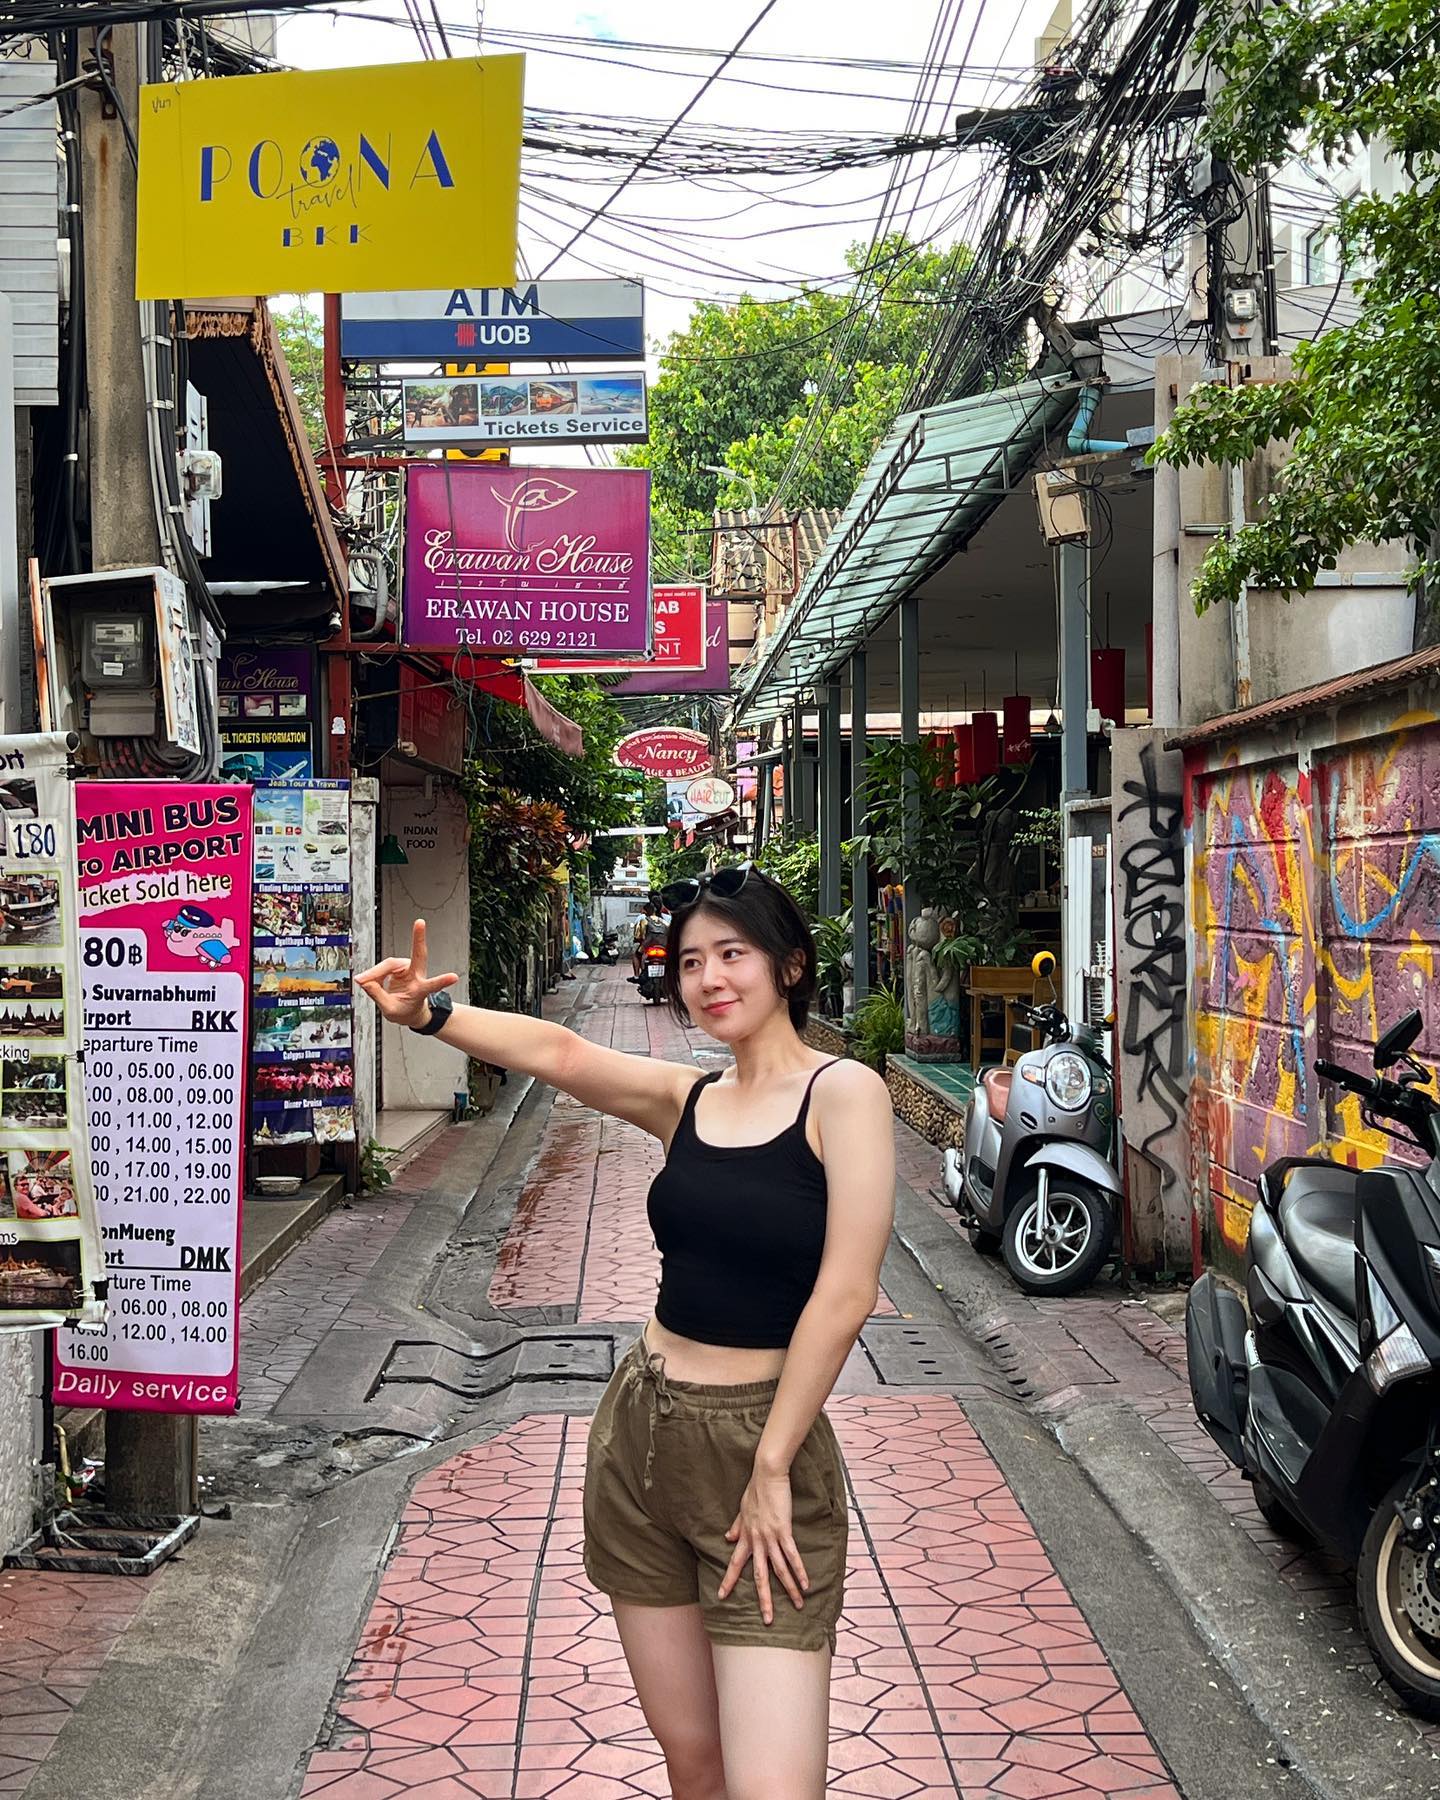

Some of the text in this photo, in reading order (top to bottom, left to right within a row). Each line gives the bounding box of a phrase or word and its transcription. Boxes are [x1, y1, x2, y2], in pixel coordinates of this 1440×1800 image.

[277, 164, 358, 219] travel
[283, 223, 373, 247] BKK
[444, 284, 541, 316] ATM
[480, 323, 531, 345] UOB
[484, 417, 643, 435] Tickets Service
[424, 529, 633, 574] Erawan House
[426, 599, 630, 623] ERAWAN HOUSE
[654, 600, 680, 615] AB
[456, 629, 597, 647] Tel. 02 629 2121
[232, 733, 260, 743] TICKETS
[262, 732, 306, 743] INFORMATION
[638, 743, 698, 764] Nancy
[676, 760, 711, 776] BEAUTY
[316, 780, 338, 788] Travel
[77, 797, 240, 844] MINI BUS
[403, 826, 438, 835] INDIAN
[13, 823, 56, 859] 180
[407, 840, 435, 849] FOOD
[112, 833, 243, 873] AIRPORT
[78, 874, 231, 907] icket Sold here
[92, 984, 216, 1002] Suvarnabhumi
[192, 1010, 237, 1031] BKK
[158, 1036, 198, 1052] Time
[181, 1246, 231, 1271] DMK
[150, 1274, 191, 1292] Time
[68, 1344, 108, 1361] 16.00
[58, 1372, 228, 1401] Daily service
